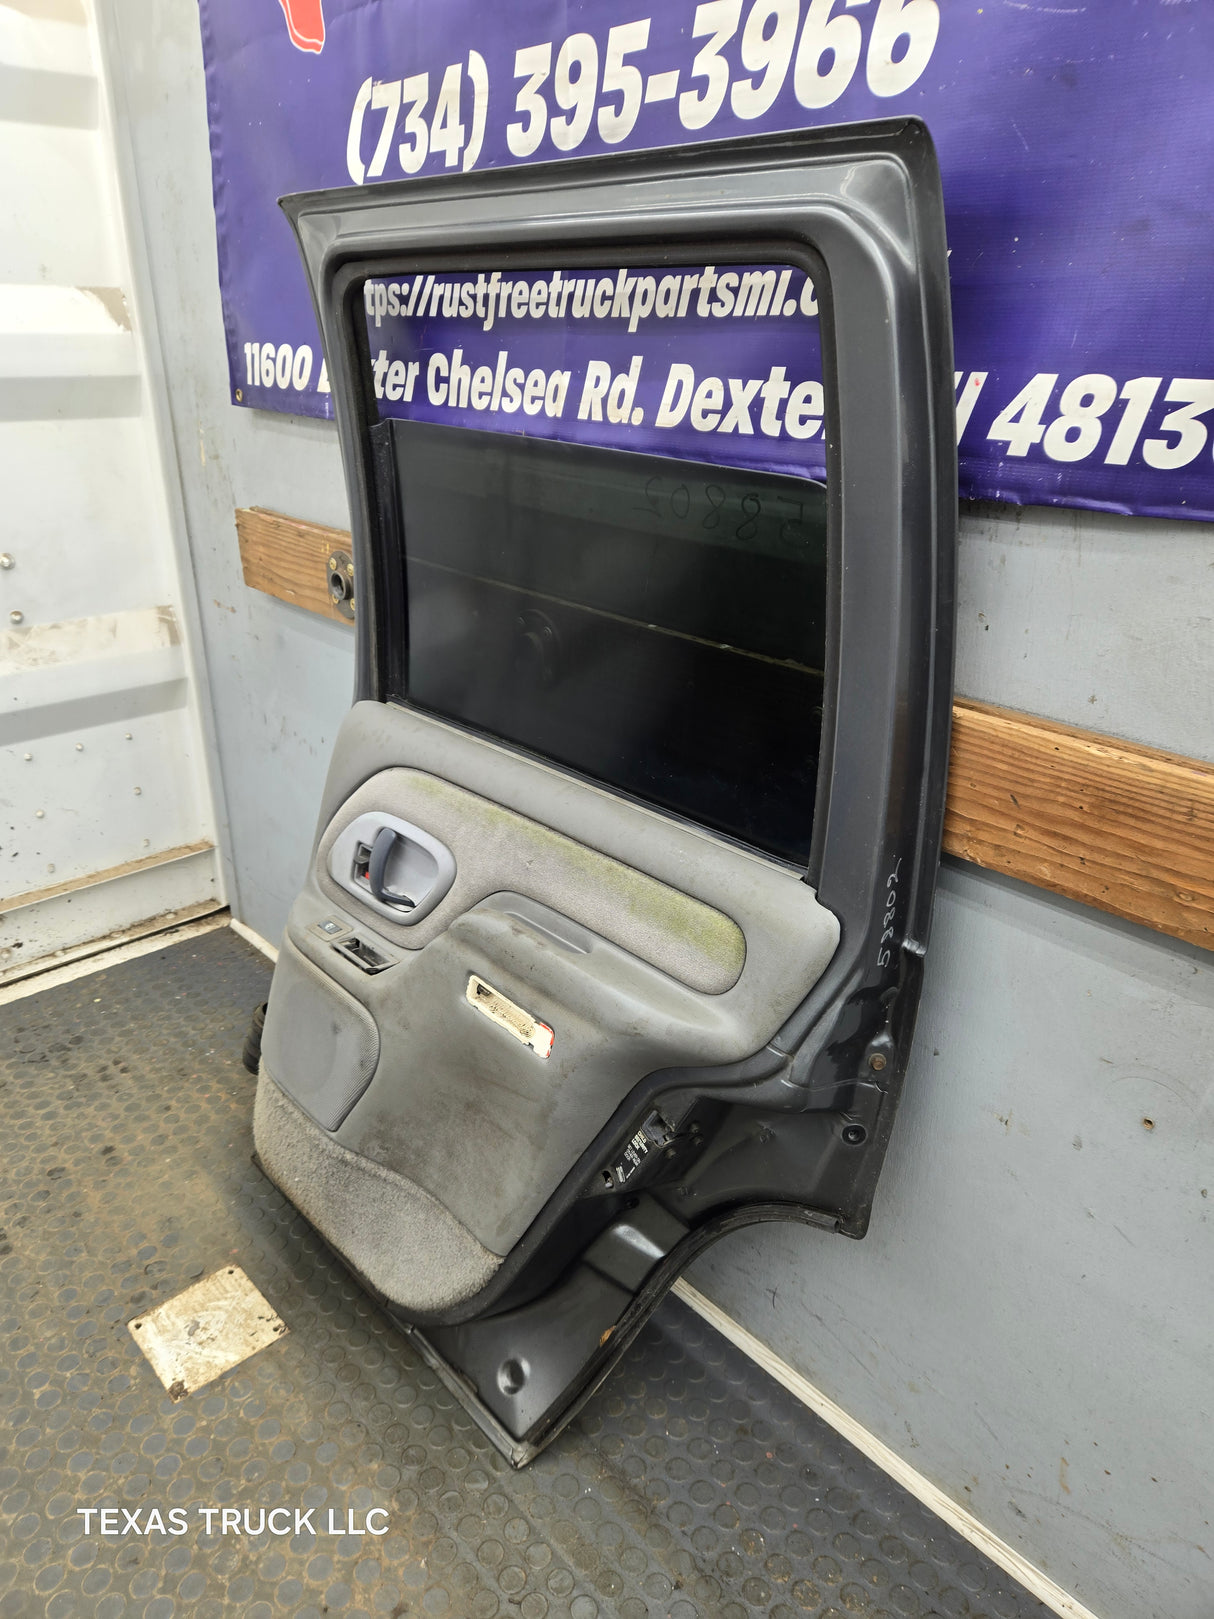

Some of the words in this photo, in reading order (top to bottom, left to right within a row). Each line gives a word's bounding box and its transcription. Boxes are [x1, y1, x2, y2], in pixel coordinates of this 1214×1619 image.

[346, 49, 489, 185] (734)
[507, 0, 940, 157] 395-3966
[364, 265, 819, 333] tps://rustfreetruckpartsmi.c
[243, 342, 314, 392] 11600
[427, 350, 572, 417] Chelsea
[577, 355, 644, 426] Rd.
[655, 363, 826, 440] Dexte
[986, 373, 1214, 470] 4813
